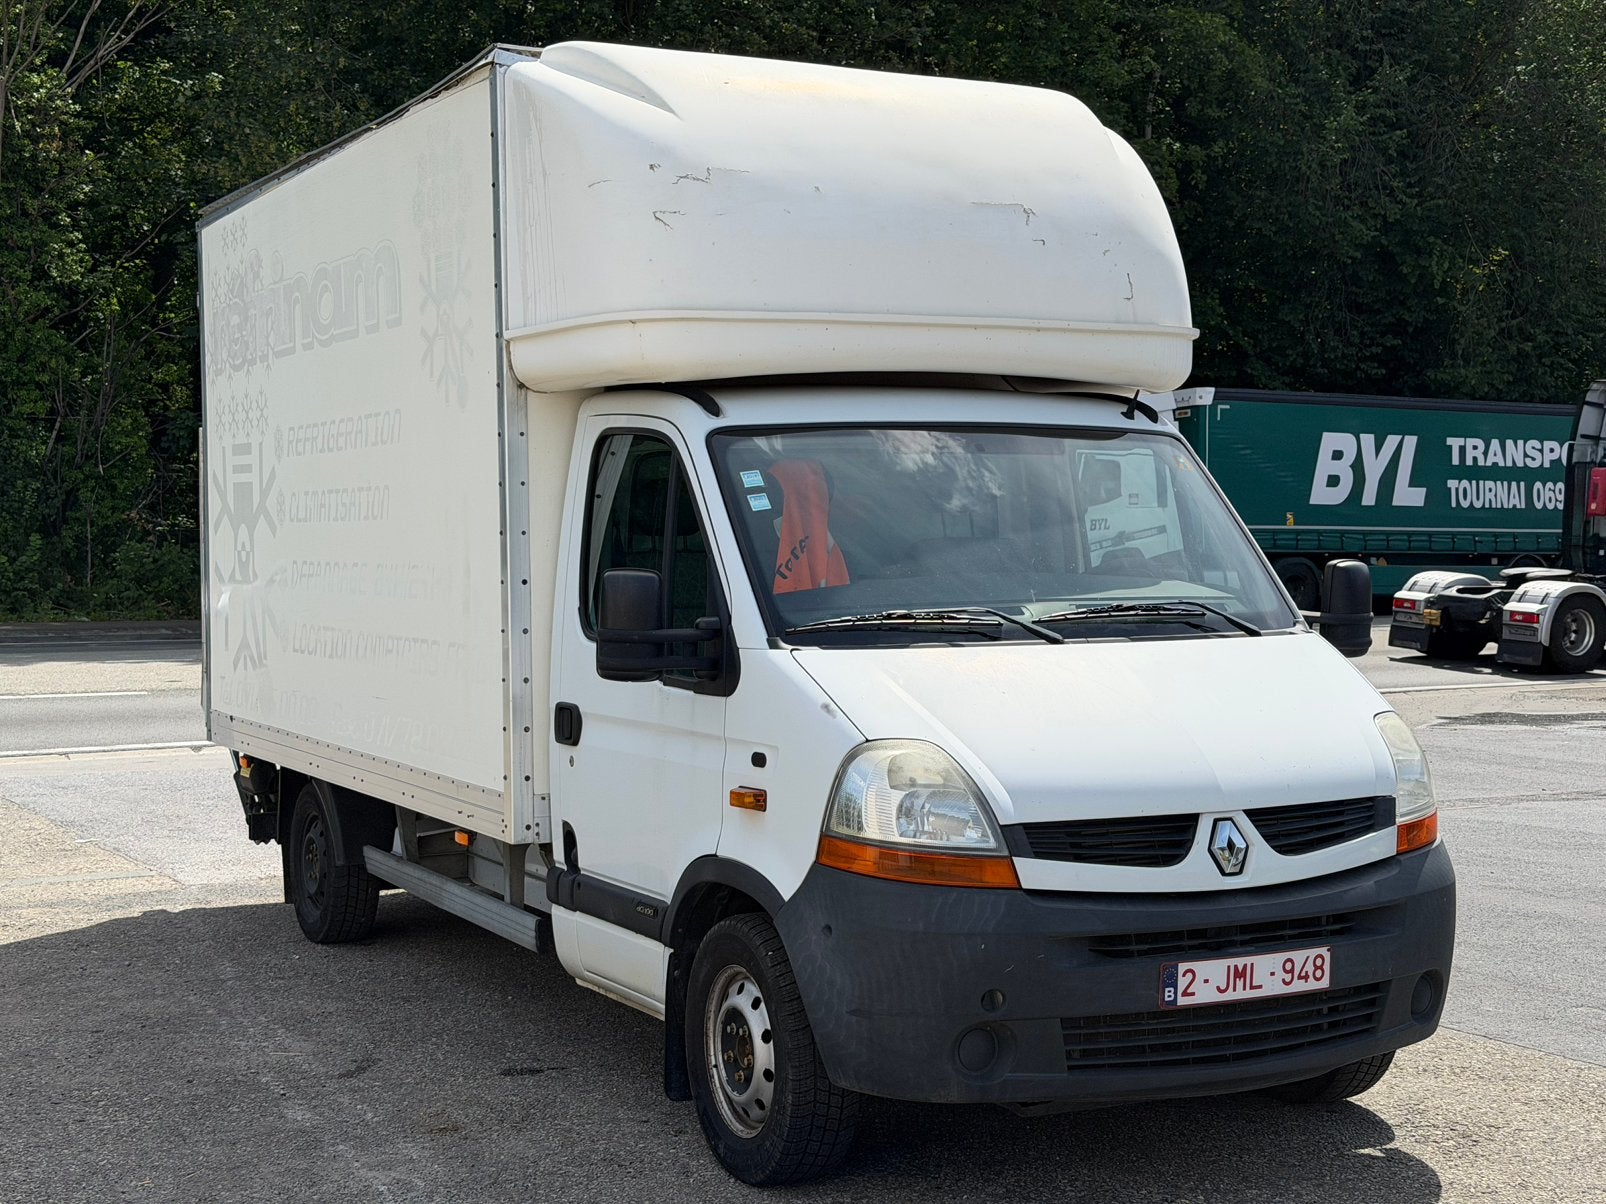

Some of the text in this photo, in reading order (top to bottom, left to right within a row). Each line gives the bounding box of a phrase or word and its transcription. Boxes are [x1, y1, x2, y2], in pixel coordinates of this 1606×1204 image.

[1309, 432, 1427, 507] BYL
[1447, 479, 1565, 510] TOURNAI 069
[1090, 518, 1110, 531] BYL
[1164, 987, 1175, 1001] B
